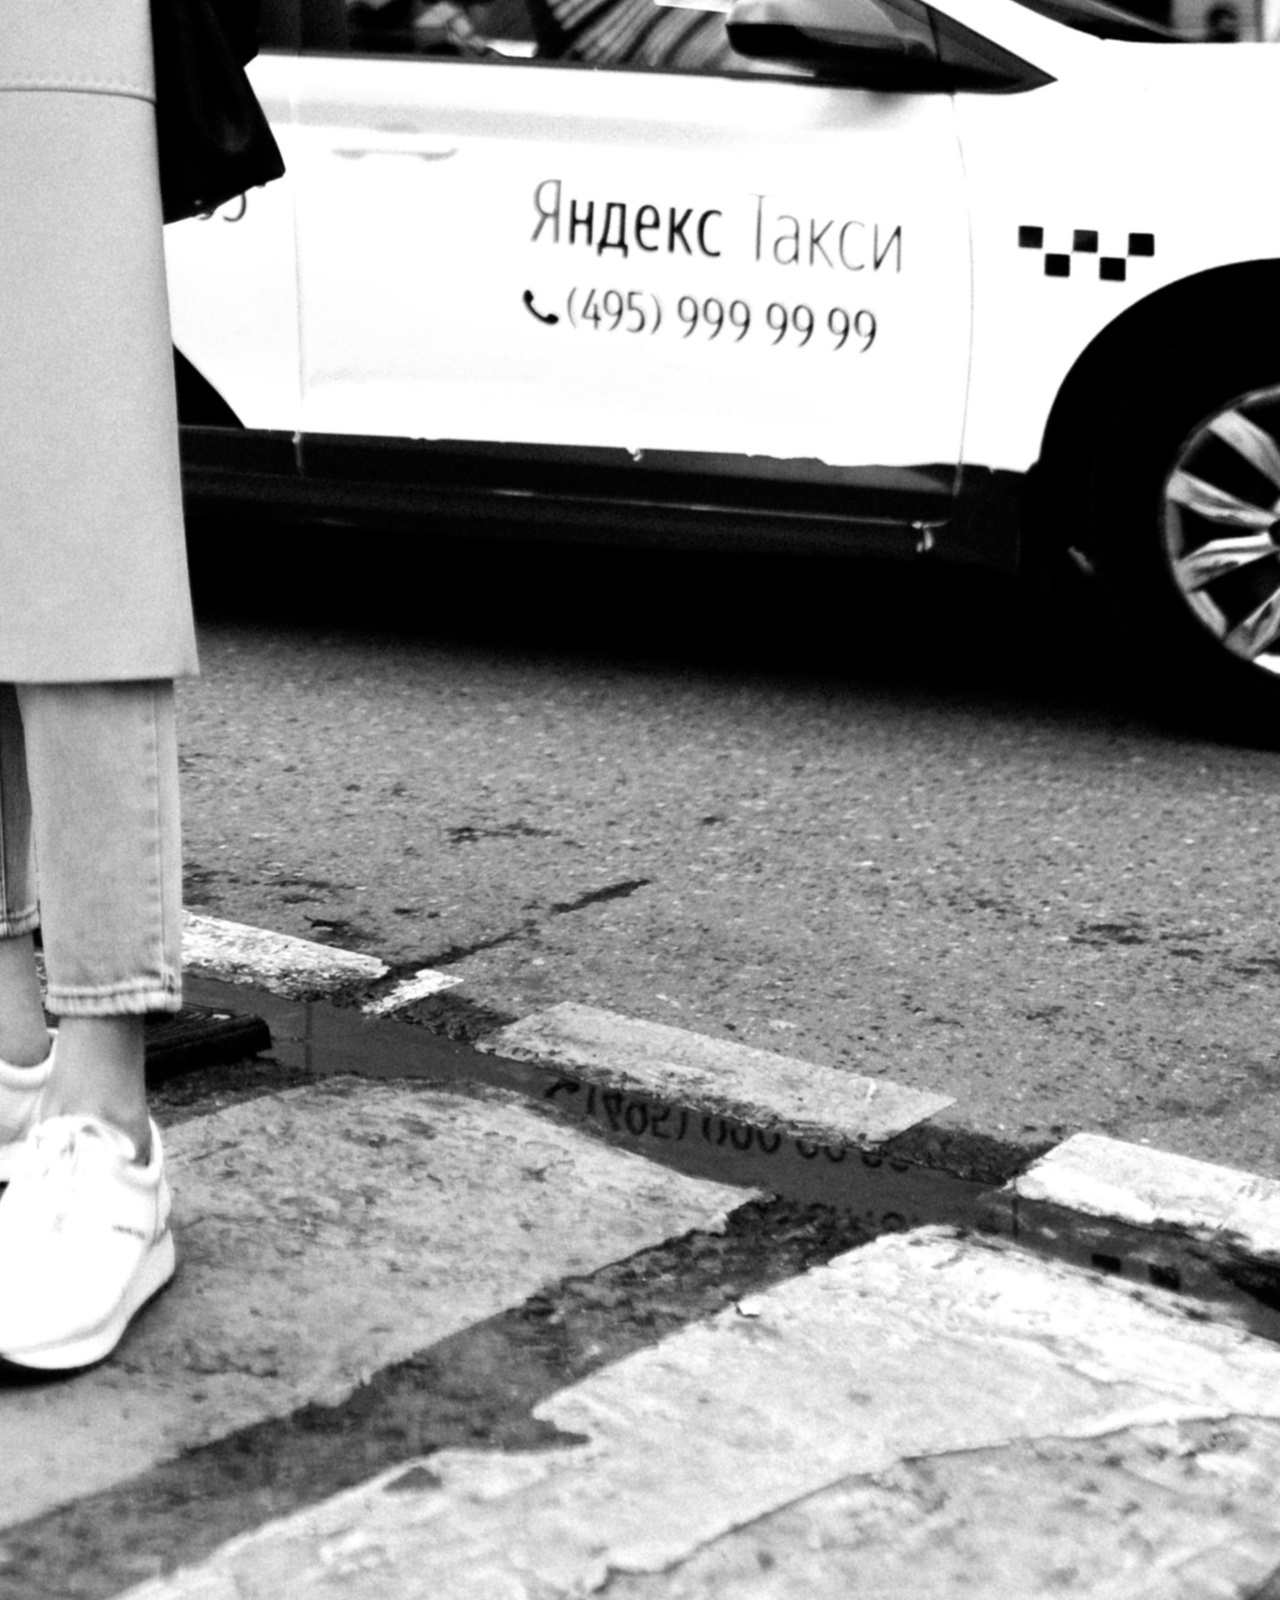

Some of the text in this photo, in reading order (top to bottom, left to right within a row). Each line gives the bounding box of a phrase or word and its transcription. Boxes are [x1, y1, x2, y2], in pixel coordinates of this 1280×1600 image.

[530, 179, 904, 275] Яндекс Такси
[566, 286, 878, 354] (495) 999 99 99
